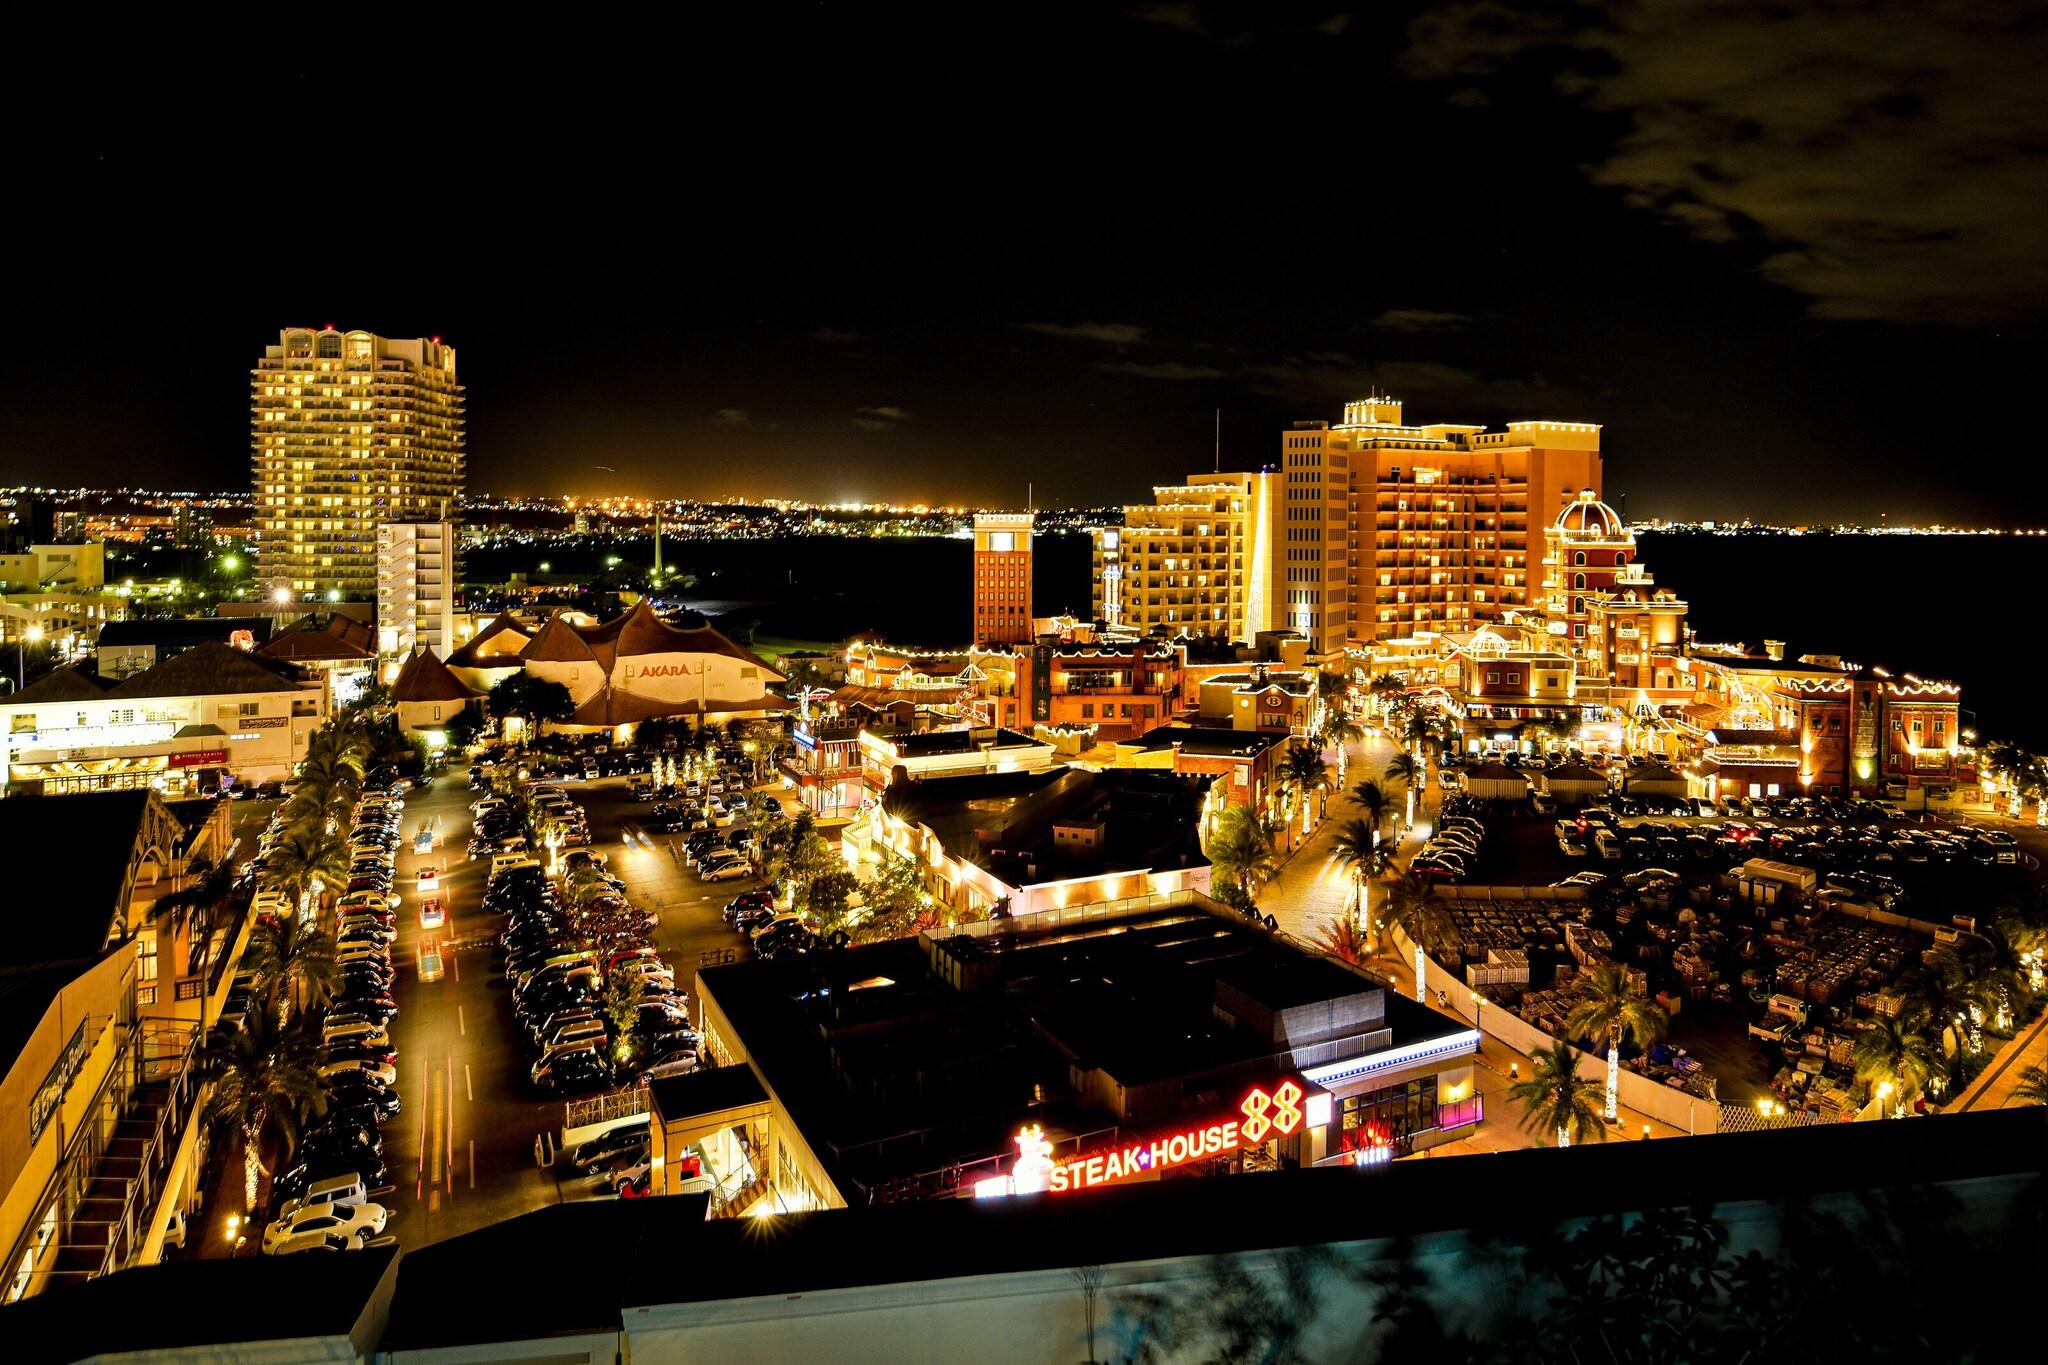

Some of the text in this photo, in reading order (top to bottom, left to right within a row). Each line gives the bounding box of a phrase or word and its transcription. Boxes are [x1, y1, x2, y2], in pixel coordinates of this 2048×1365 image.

[638, 664, 691, 678] AKARA
[1050, 1081, 1302, 1192] STEAK HOUSE 88
